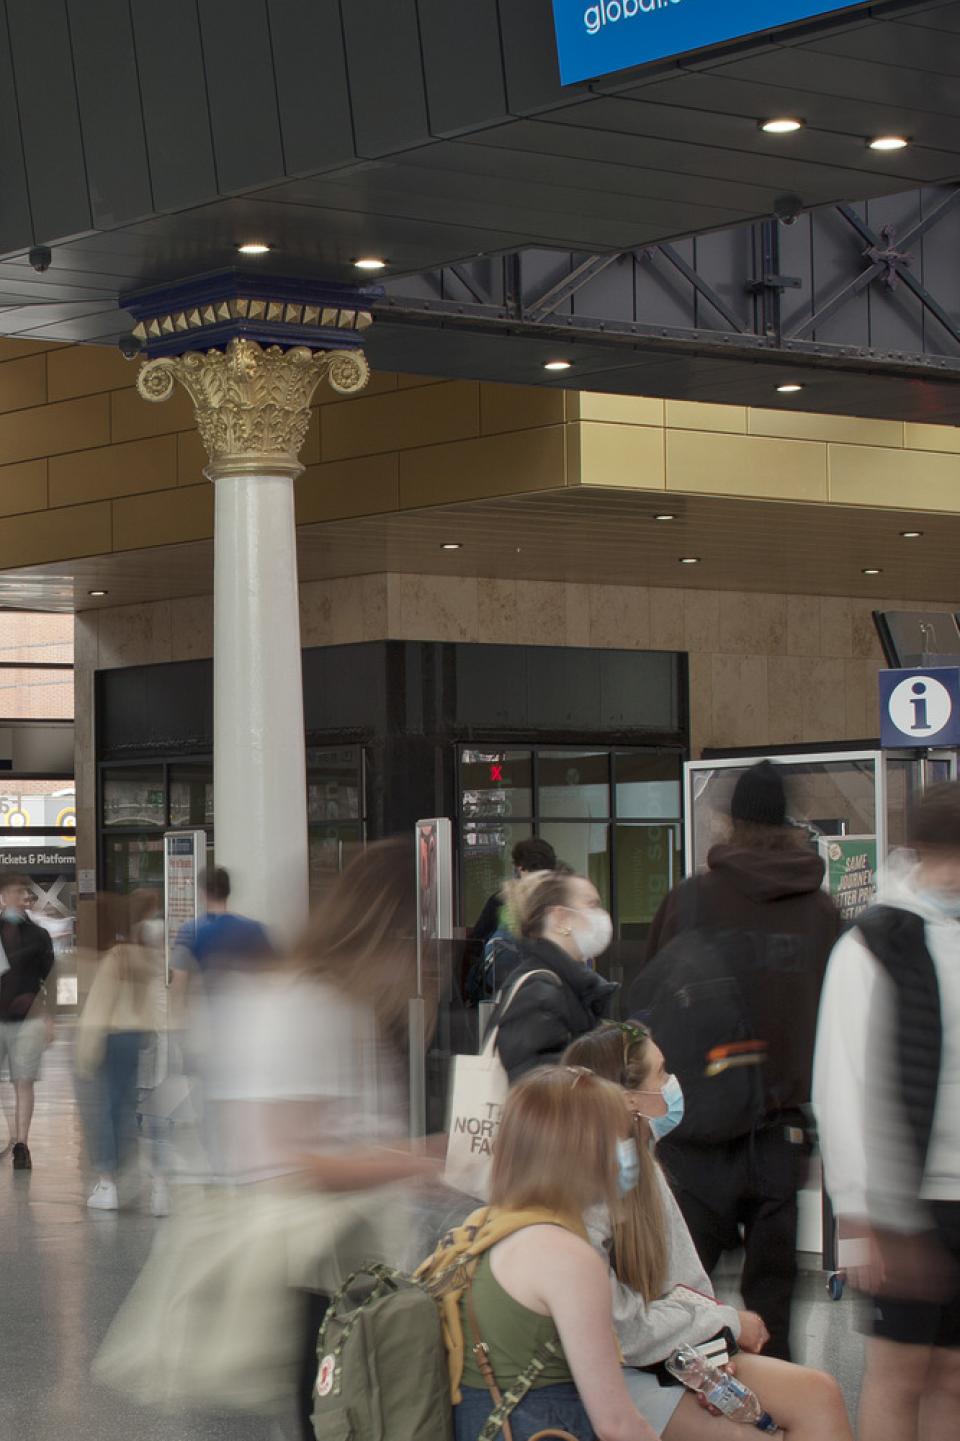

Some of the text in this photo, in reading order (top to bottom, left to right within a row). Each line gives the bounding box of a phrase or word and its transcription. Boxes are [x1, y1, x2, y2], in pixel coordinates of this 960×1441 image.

[28, 854, 36, 864] &
[36, 852, 77, 864] Platform
[454, 1117, 500, 1137] NOR
[470, 1135, 495, 1155] FA
